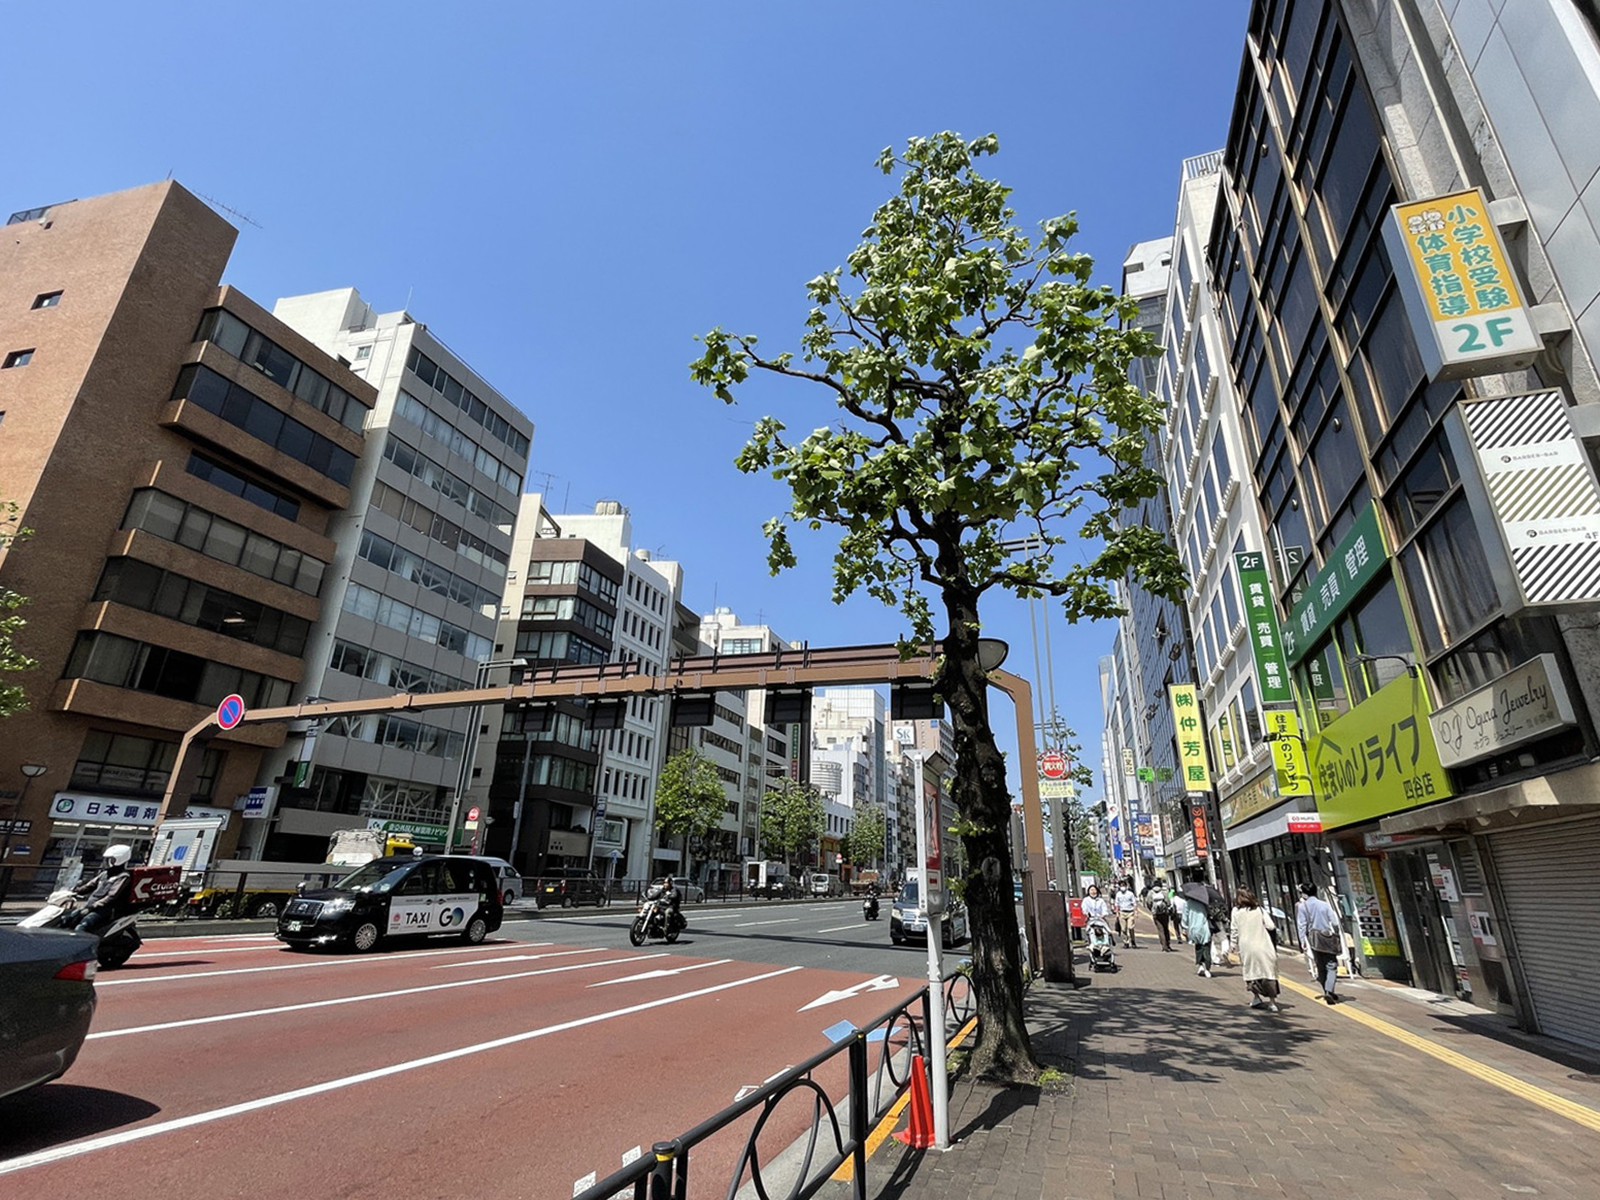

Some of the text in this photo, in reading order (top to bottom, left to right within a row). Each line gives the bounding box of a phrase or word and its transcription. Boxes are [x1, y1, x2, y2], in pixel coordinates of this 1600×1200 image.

[1447, 204, 1511, 310] 小学校受験
[1416, 232, 1471, 316] 体育指導
[1451, 316, 1514, 353] 2F
[1240, 556, 1260, 569] 2F
[1263, 661, 1283, 689] 管理
[1500, 675, 1548, 725] Jewelry
[1402, 771, 1436, 800] 四谷店
[86, 801, 158, 820] 日本調剤
[405, 912, 431, 925] TAXI
[439, 907, 464, 927] GO
